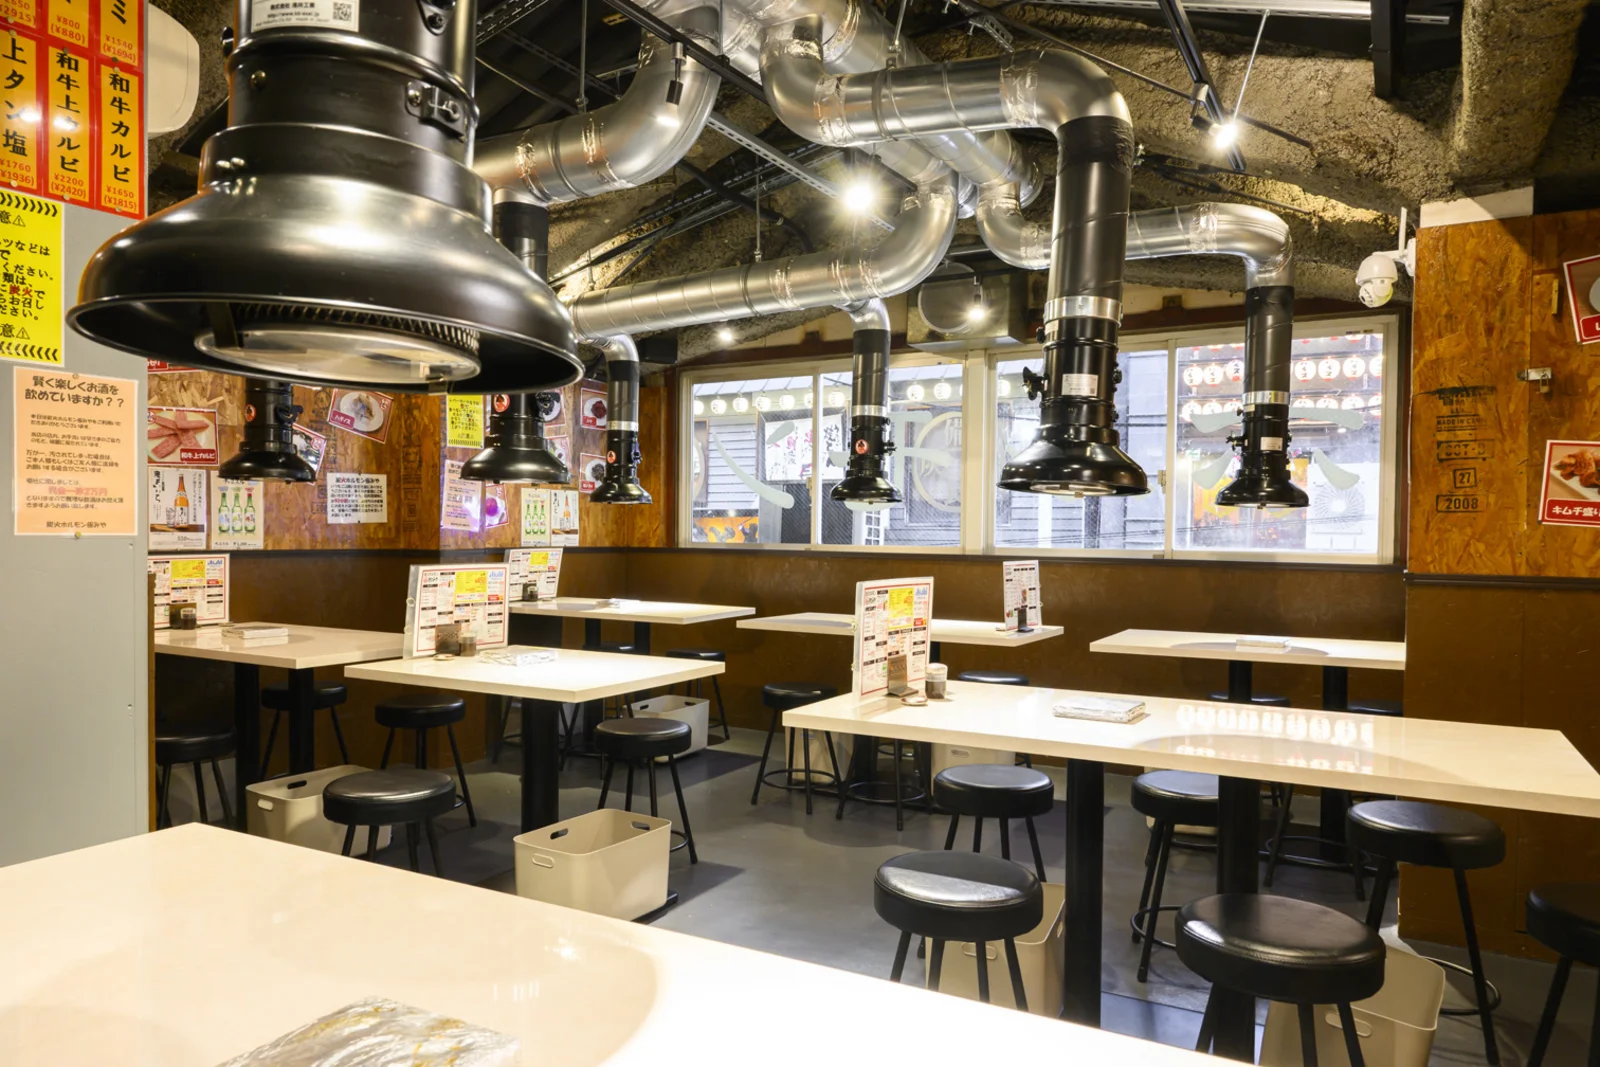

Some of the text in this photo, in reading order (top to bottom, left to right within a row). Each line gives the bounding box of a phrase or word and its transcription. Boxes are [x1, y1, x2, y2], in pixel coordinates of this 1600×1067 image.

[56, 15, 80, 30] ¥800
[50, 23, 86, 45] (¥880)
[105, 34, 133, 50] ¥1540
[103, 42, 136, 63] (¥1694)
[2, 37, 28, 157] 上タン塩
[108, 73, 132, 183] 和牛カルビ
[54, 173, 84, 187] ¥2200
[51, 181, 86, 199] (¥2420)
[106, 185, 134, 199] ¥1650
[104, 194, 137, 211] (¥1815)
[3, 262, 54, 280] ください。
[33, 375, 119, 395] 賢く楽しくお酒を
[1459, 472, 1471, 484] 27
[1446, 498, 1478, 510] 2008
